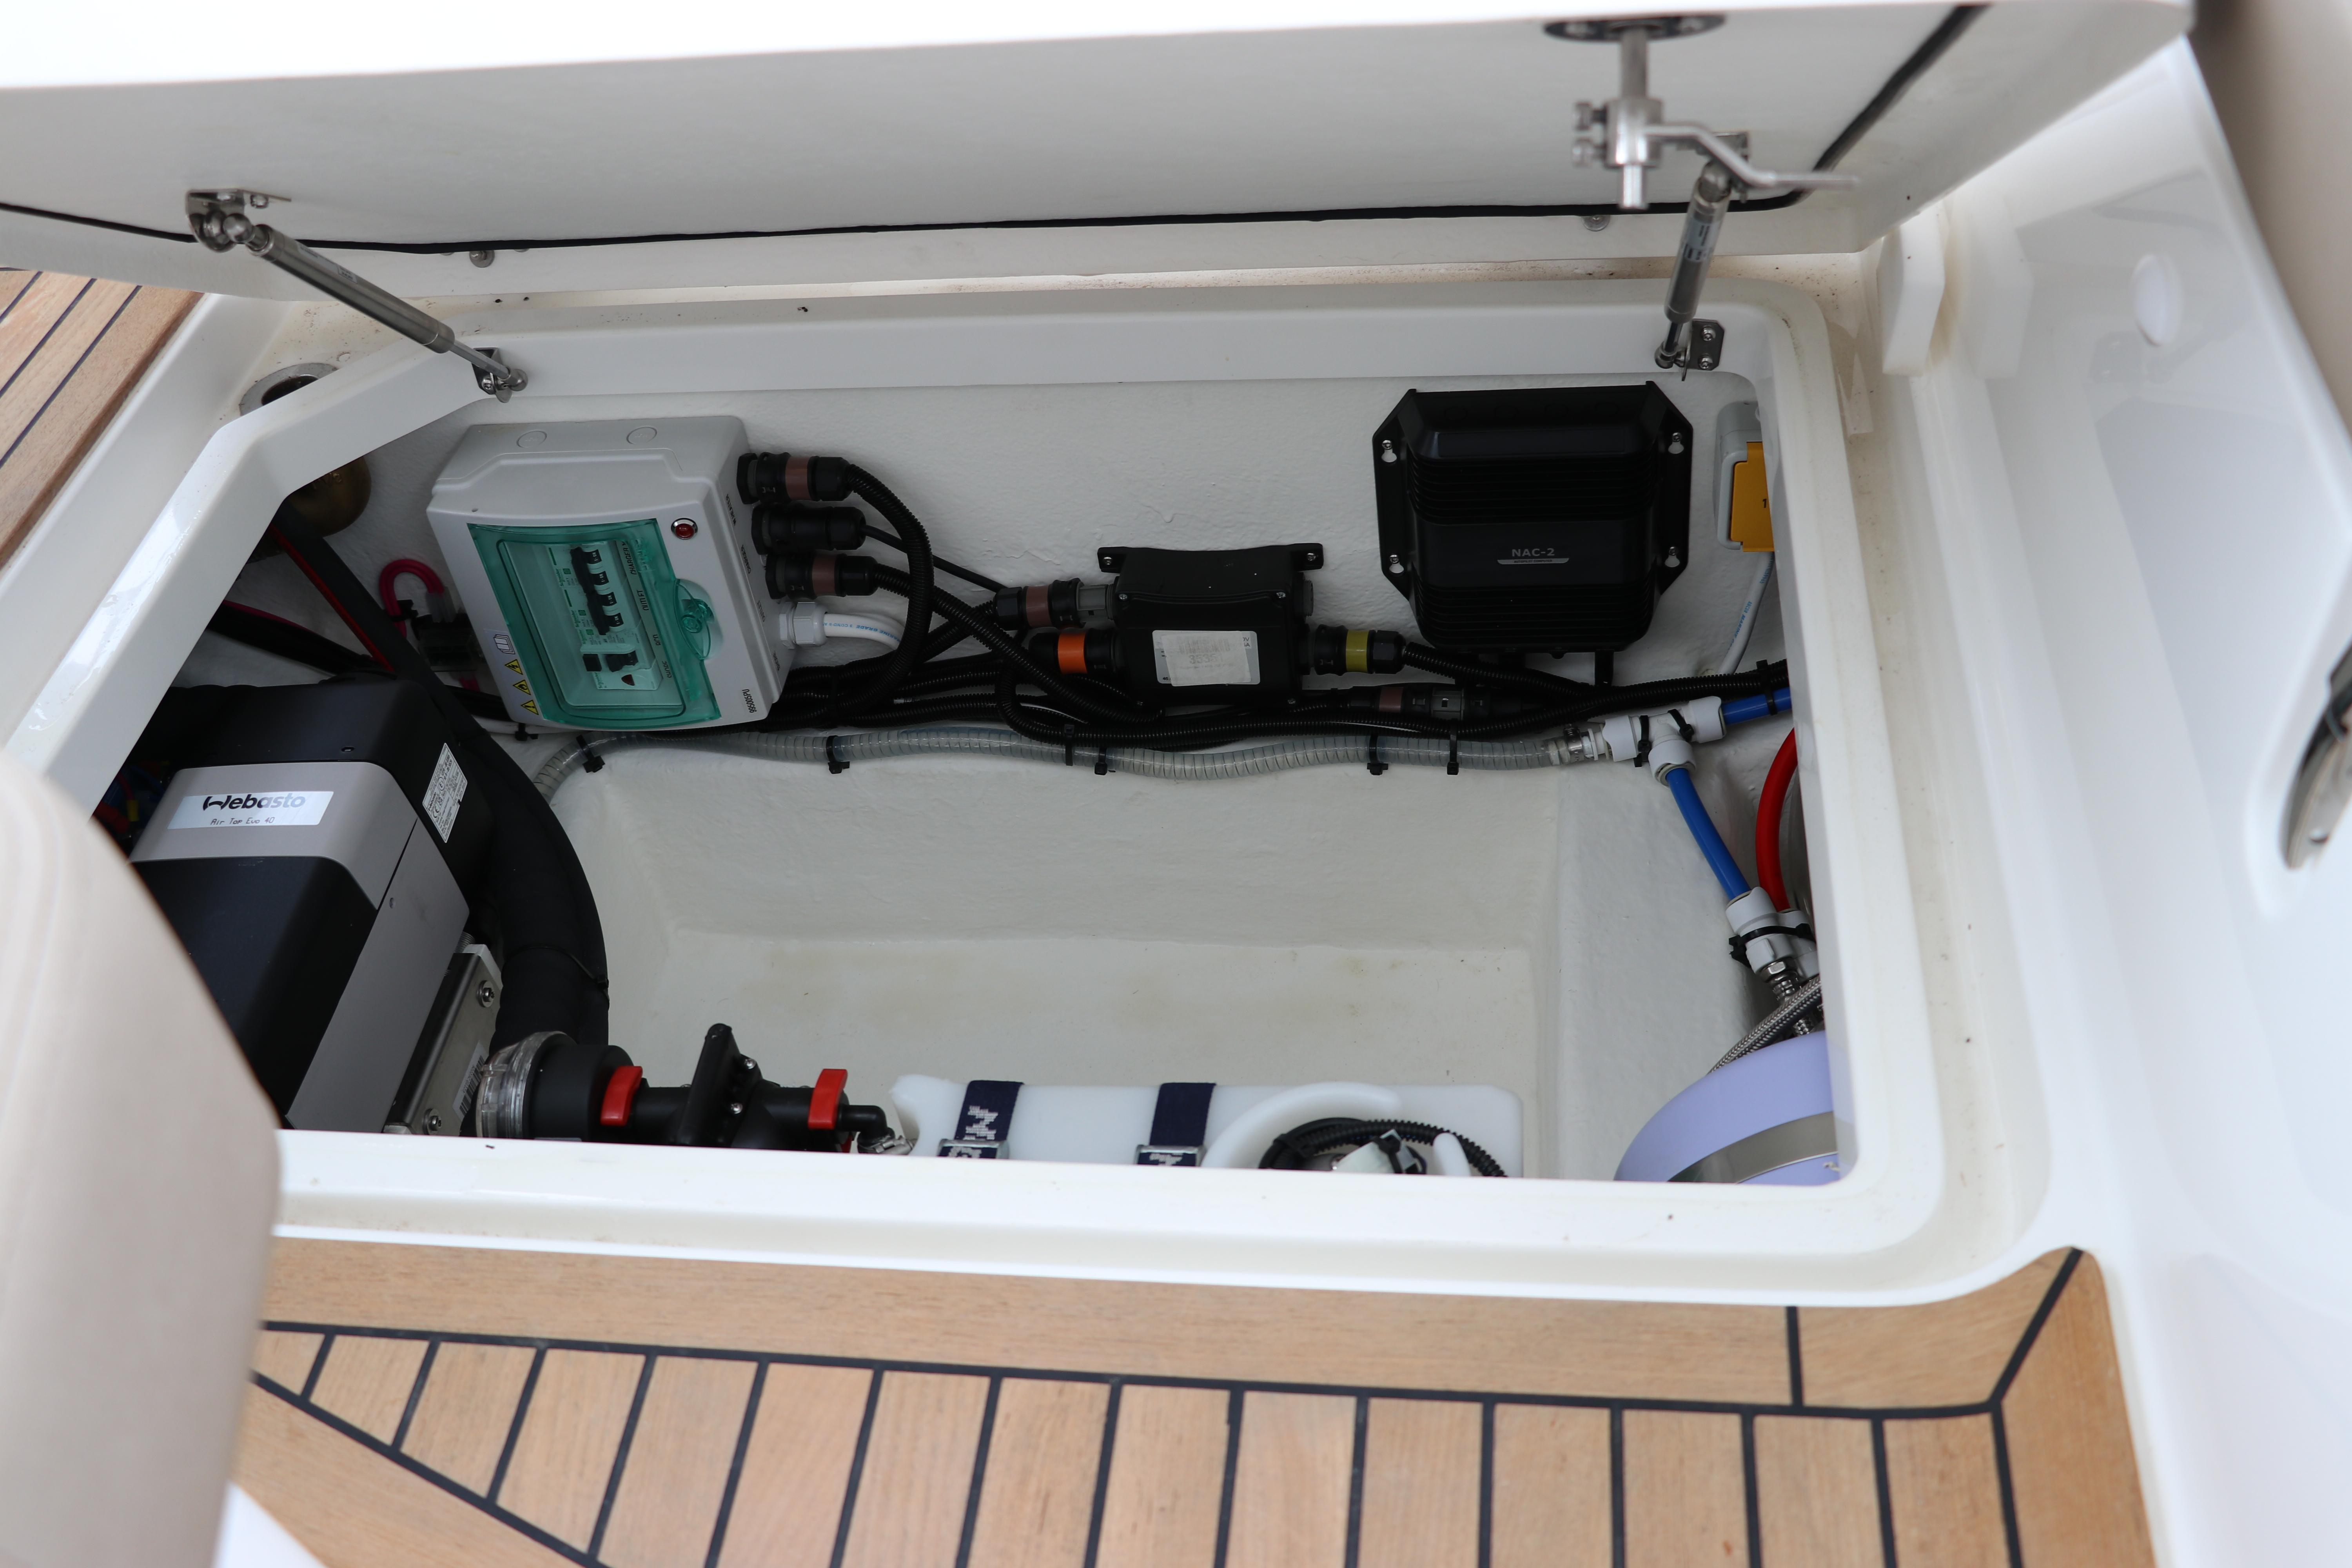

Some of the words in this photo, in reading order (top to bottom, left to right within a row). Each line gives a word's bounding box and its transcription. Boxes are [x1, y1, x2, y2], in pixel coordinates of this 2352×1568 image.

[1512, 548, 1555, 557] NAC-2
[742, 689, 757, 713] 995005PU
[203, 793, 306, 811] Webasto
